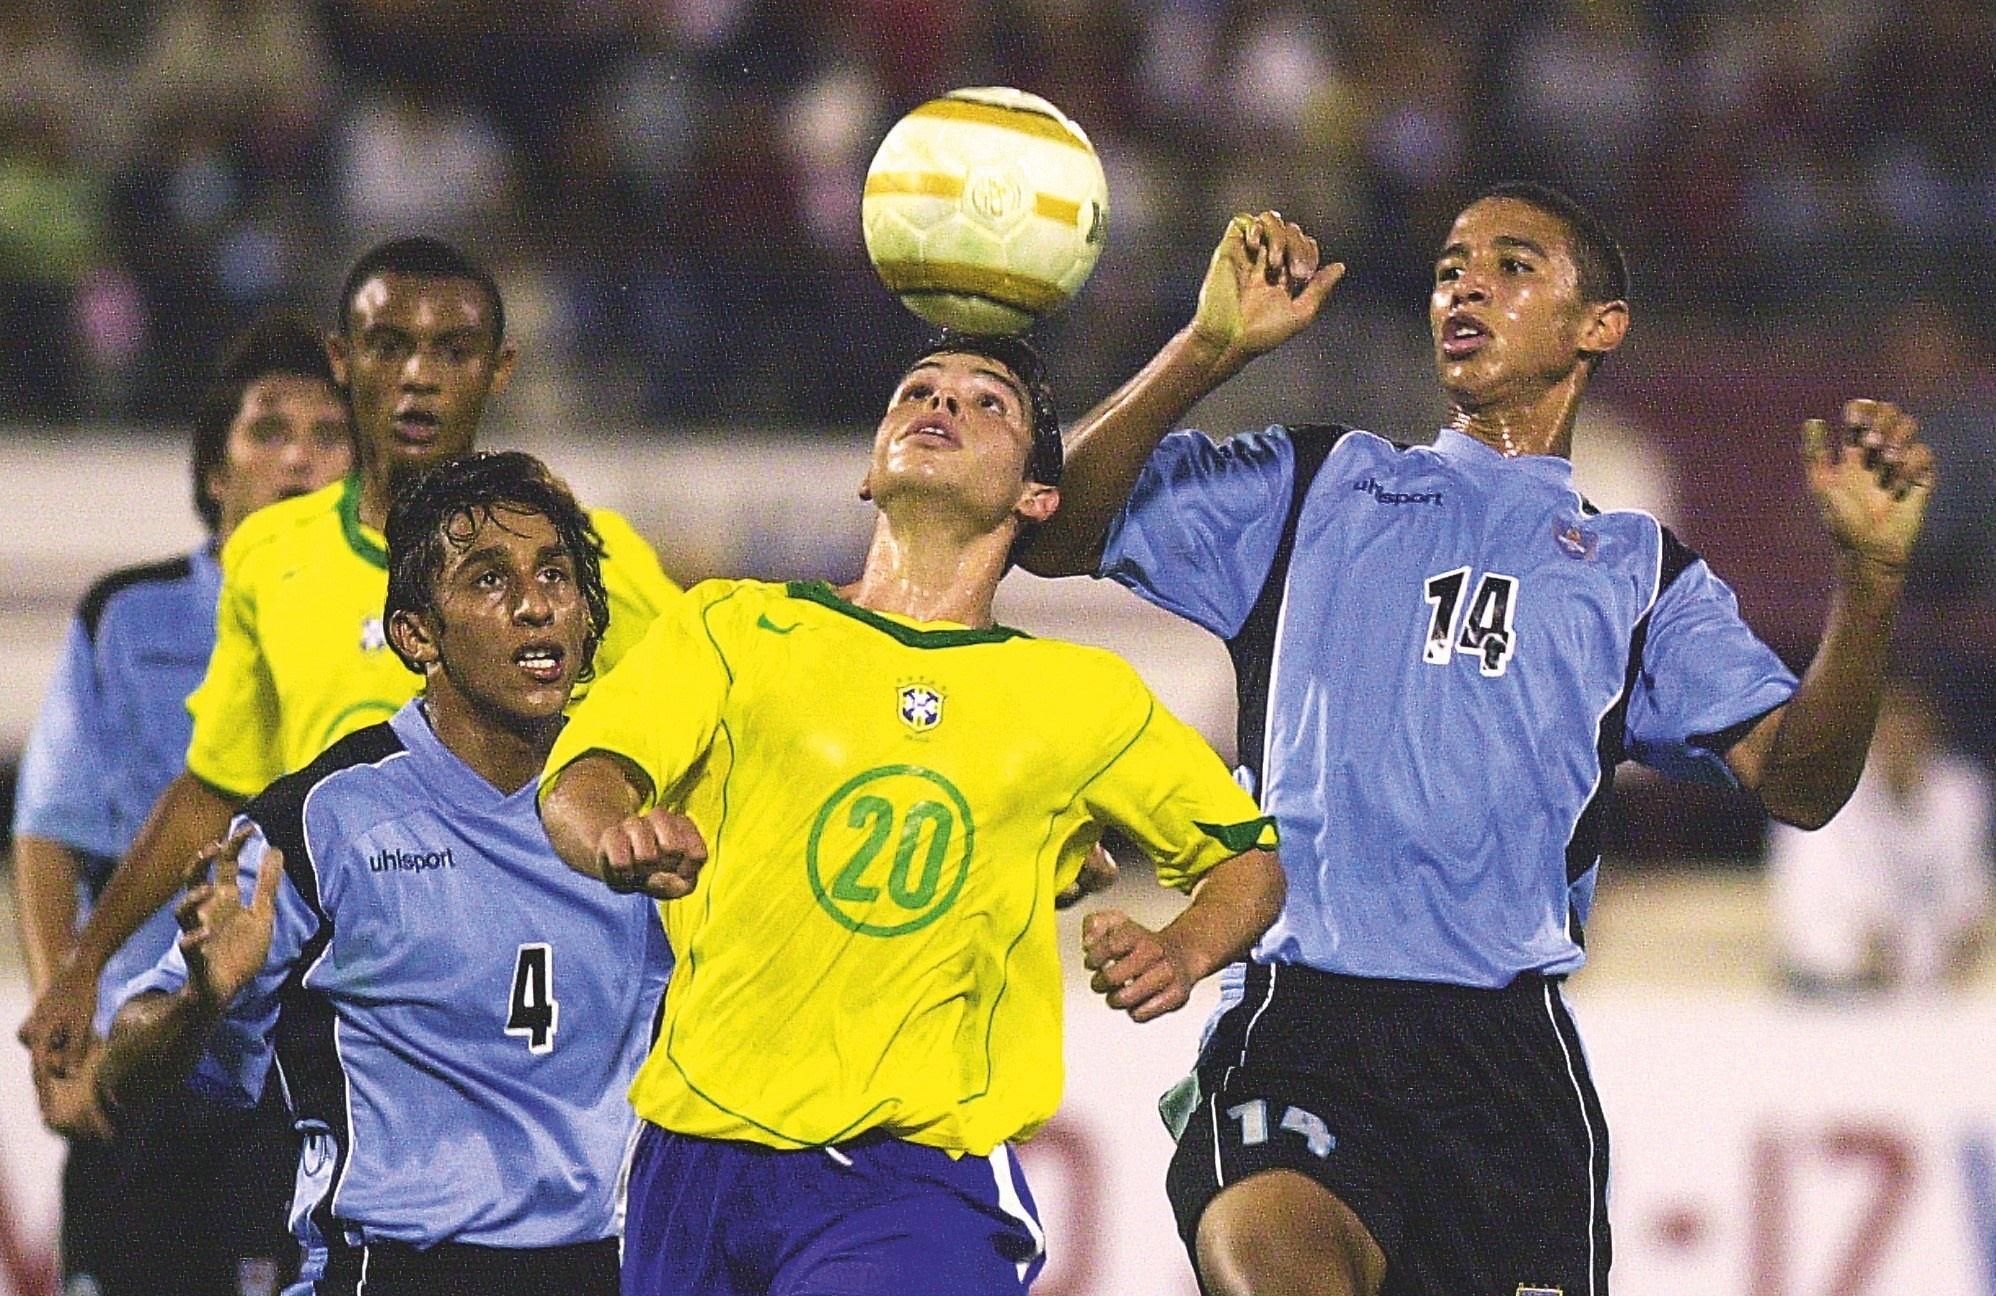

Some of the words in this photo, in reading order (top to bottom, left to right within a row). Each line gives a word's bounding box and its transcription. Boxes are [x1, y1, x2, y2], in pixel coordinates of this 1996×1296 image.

[1423, 566, 1519, 677] 14
[369, 847, 456, 874] uhlsport
[832, 795, 953, 910] 20
[504, 942, 559, 1055] 4
